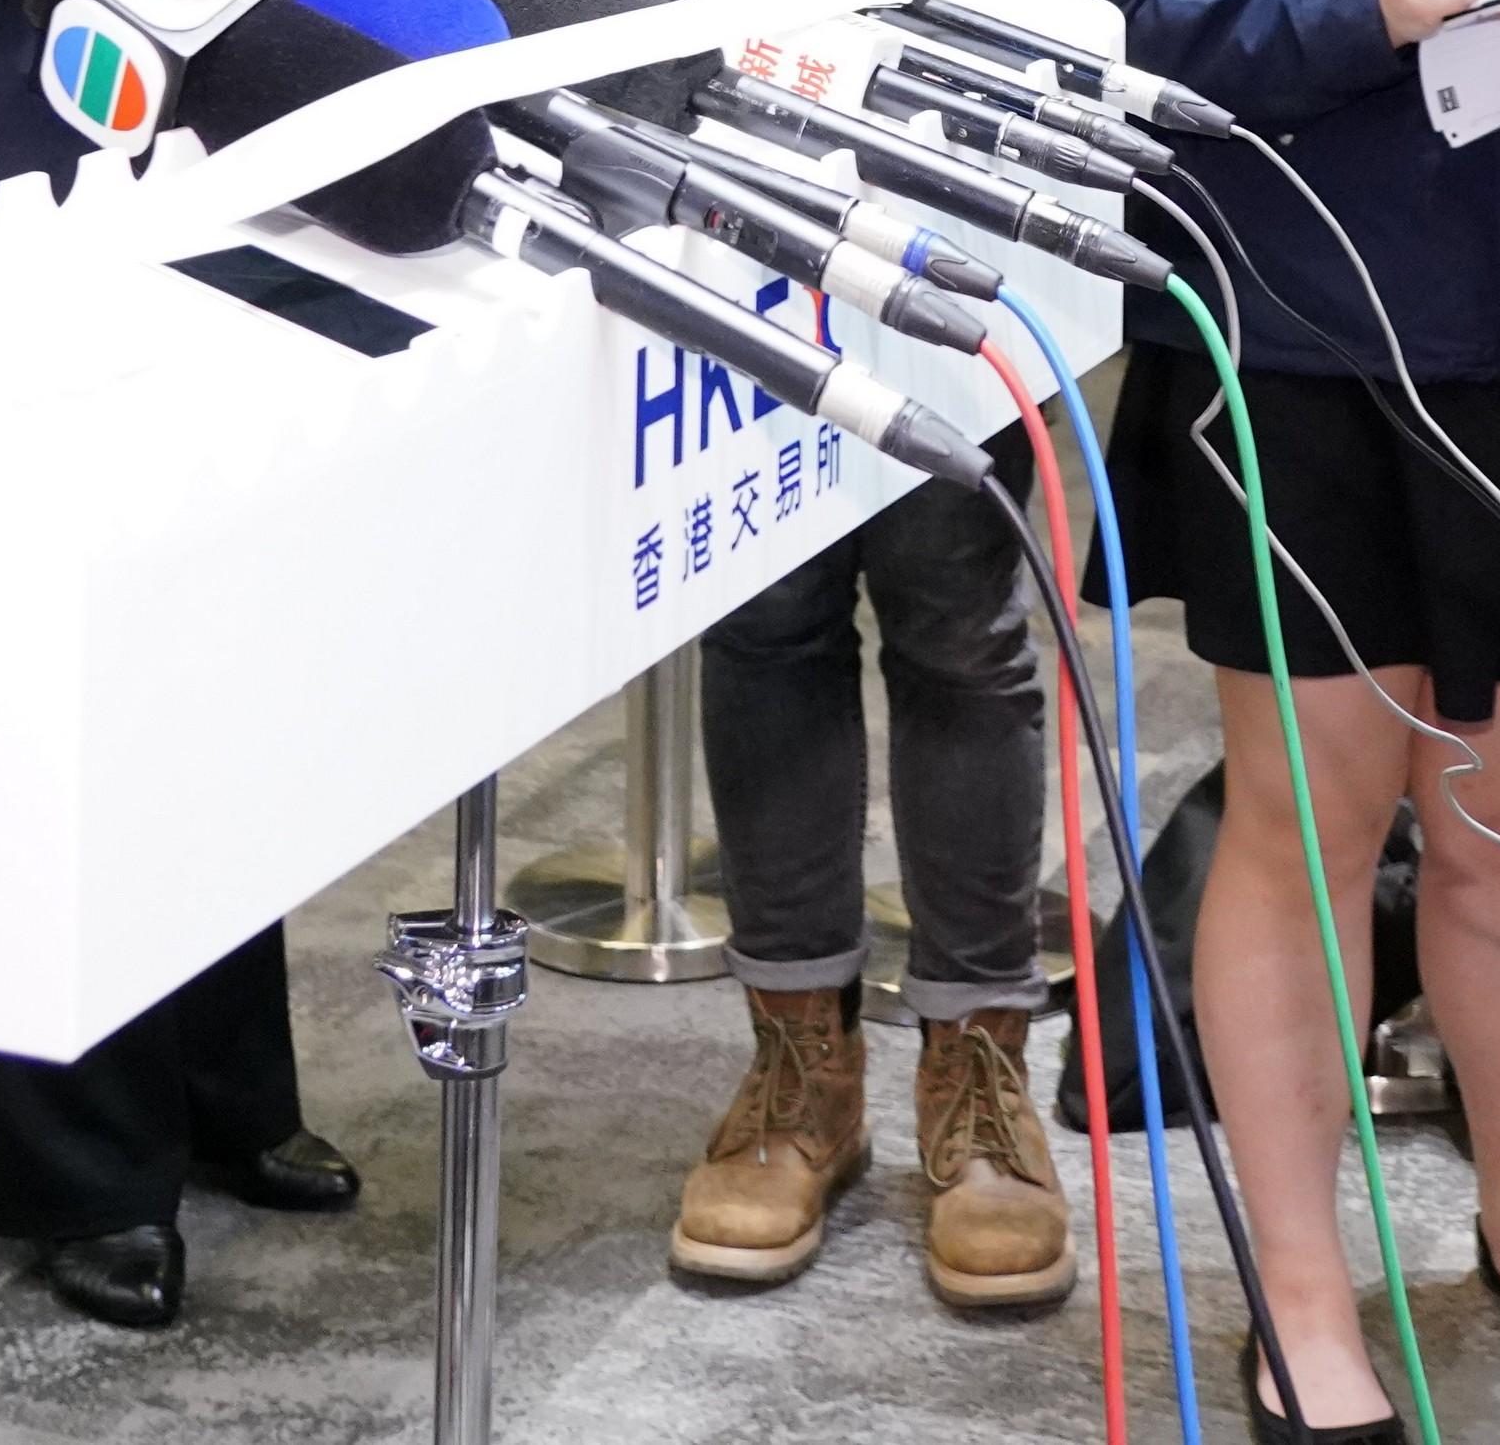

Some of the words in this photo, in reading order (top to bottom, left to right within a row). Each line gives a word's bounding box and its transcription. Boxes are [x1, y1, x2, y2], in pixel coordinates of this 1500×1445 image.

[632, 421, 842, 611] 香港交易所
